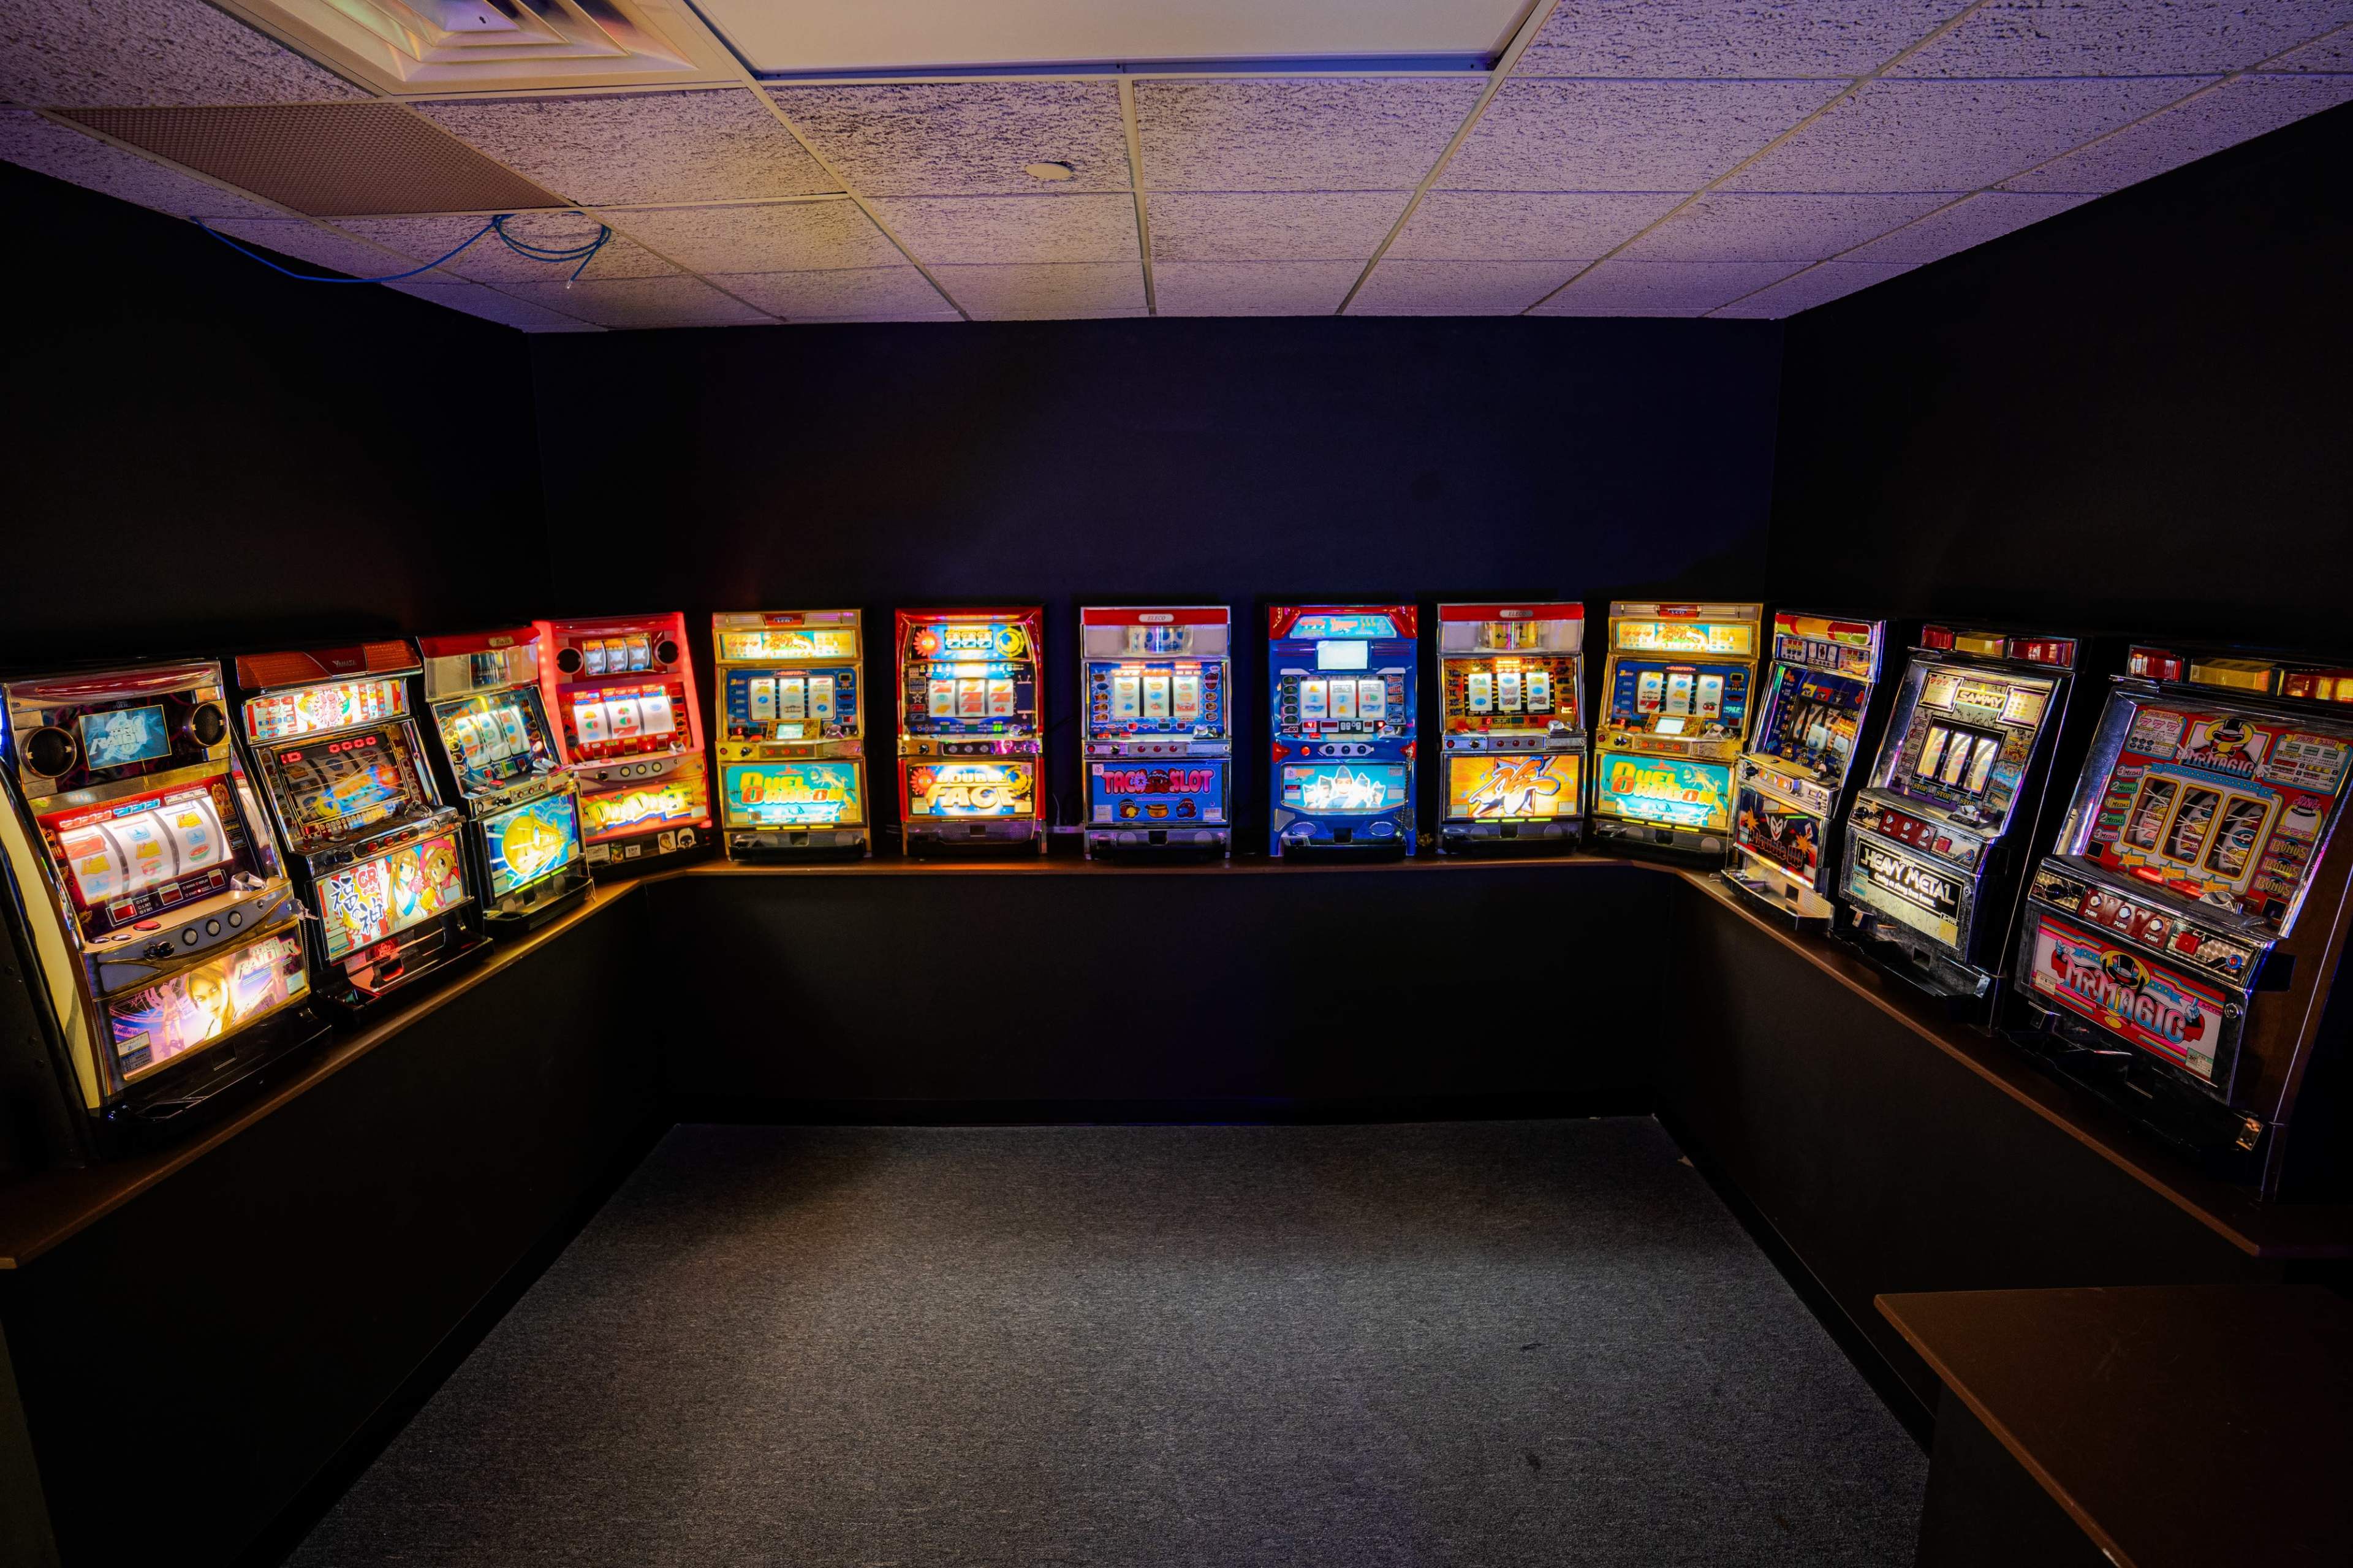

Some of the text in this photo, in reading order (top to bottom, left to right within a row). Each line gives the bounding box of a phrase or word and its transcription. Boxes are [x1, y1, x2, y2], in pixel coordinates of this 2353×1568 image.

[1957, 691, 2004, 709] SAMMY
[1169, 768, 1215, 793] SLOT
[1913, 783, 1928, 793] STOP
[926, 784, 1020, 809] FACE
[1936, 789, 1952, 800] STOP
[2272, 838, 2309, 859] BONUS
[1860, 847, 1957, 906] HEAVY METAL
[2264, 857, 2300, 879] BONUS
[357, 868, 379, 889] CR
[2256, 876, 2292, 896] BONUS
[2085, 909, 2097, 918] PUSH
[2113, 920, 2128, 930] PUSH
[2144, 933, 2159, 943] PUSH
[2196, 953, 2211, 962] BET
[2094, 968, 2187, 1044] MAGIC
